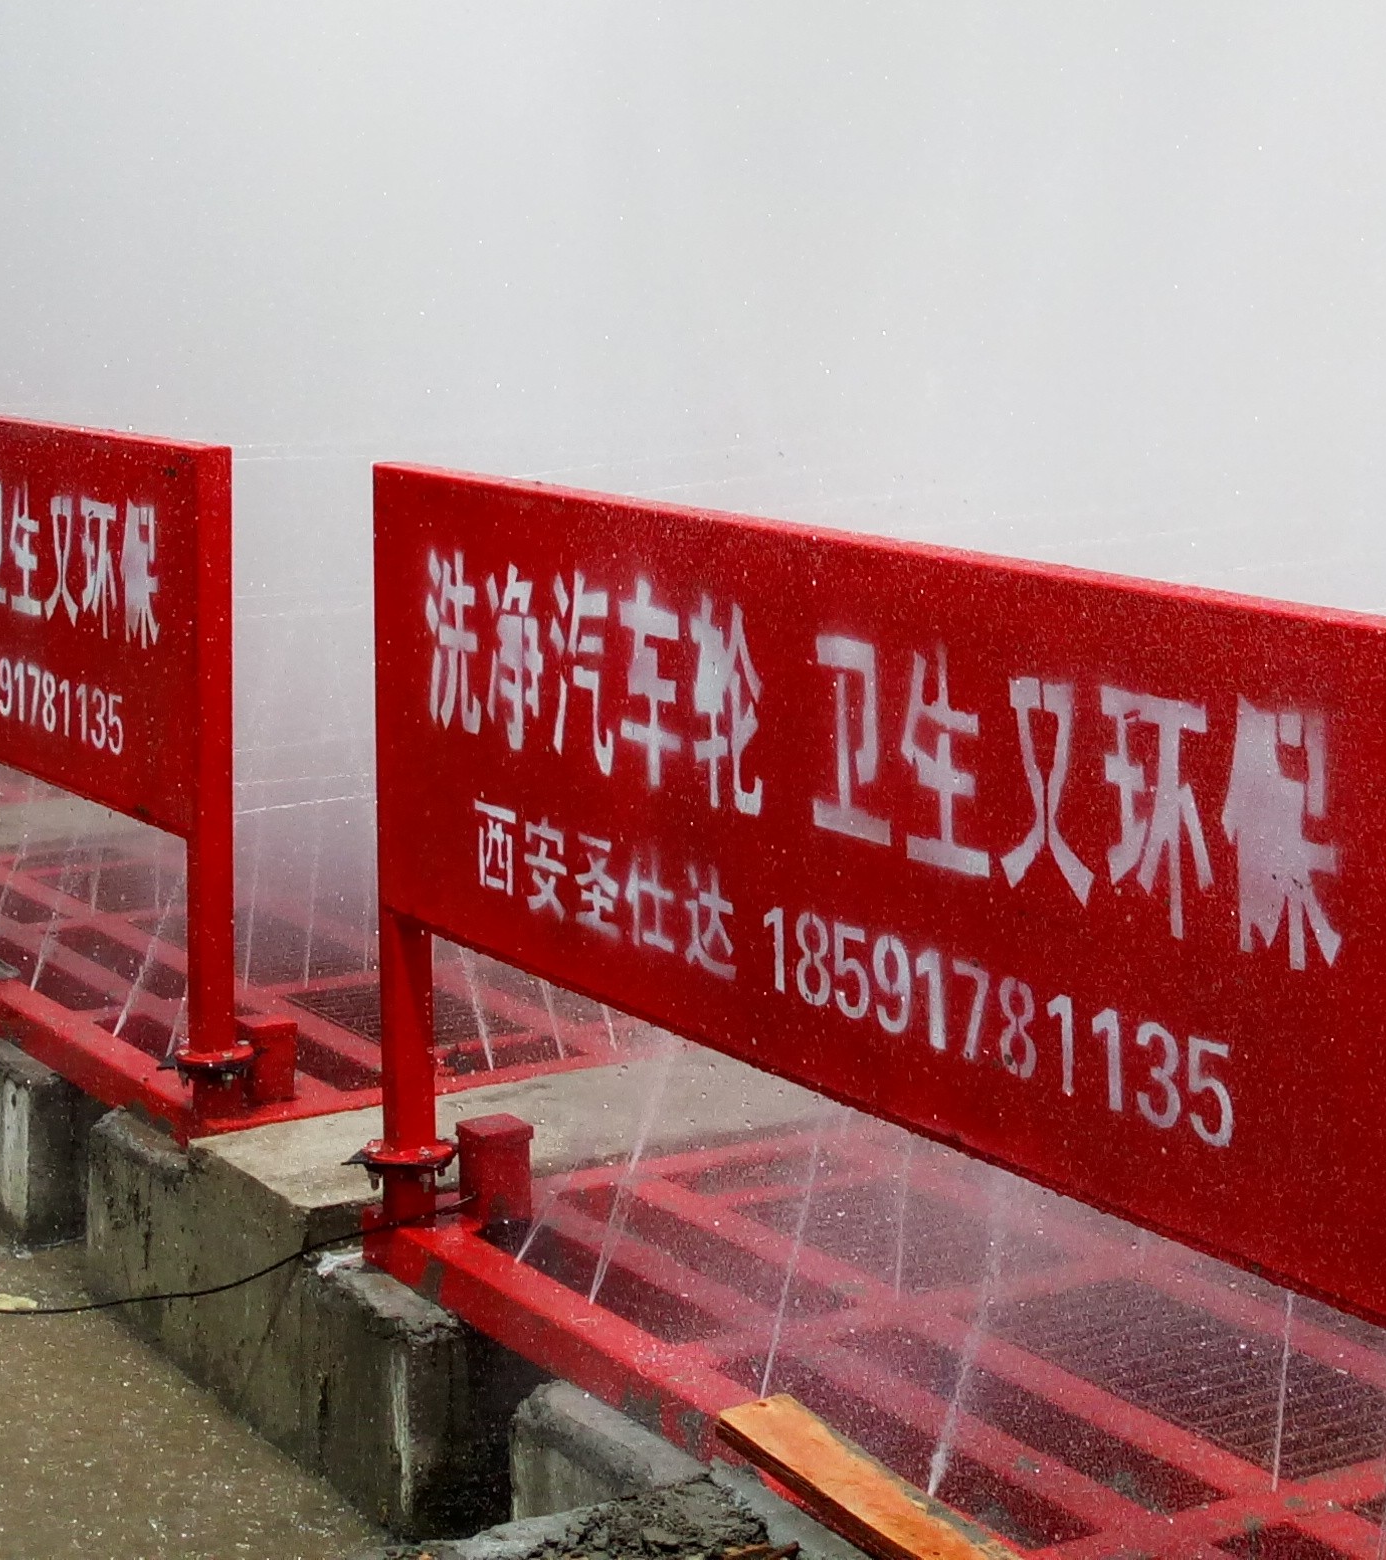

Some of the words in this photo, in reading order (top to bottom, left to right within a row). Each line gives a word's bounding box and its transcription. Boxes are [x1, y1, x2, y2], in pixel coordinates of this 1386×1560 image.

[423, 550, 764, 817] 洗净汽车轮
[813, 633, 1344, 972] 卫生又环保
[474, 797, 737, 981] 西安圣仕达
[763, 906, 1235, 1148] 18591781135
